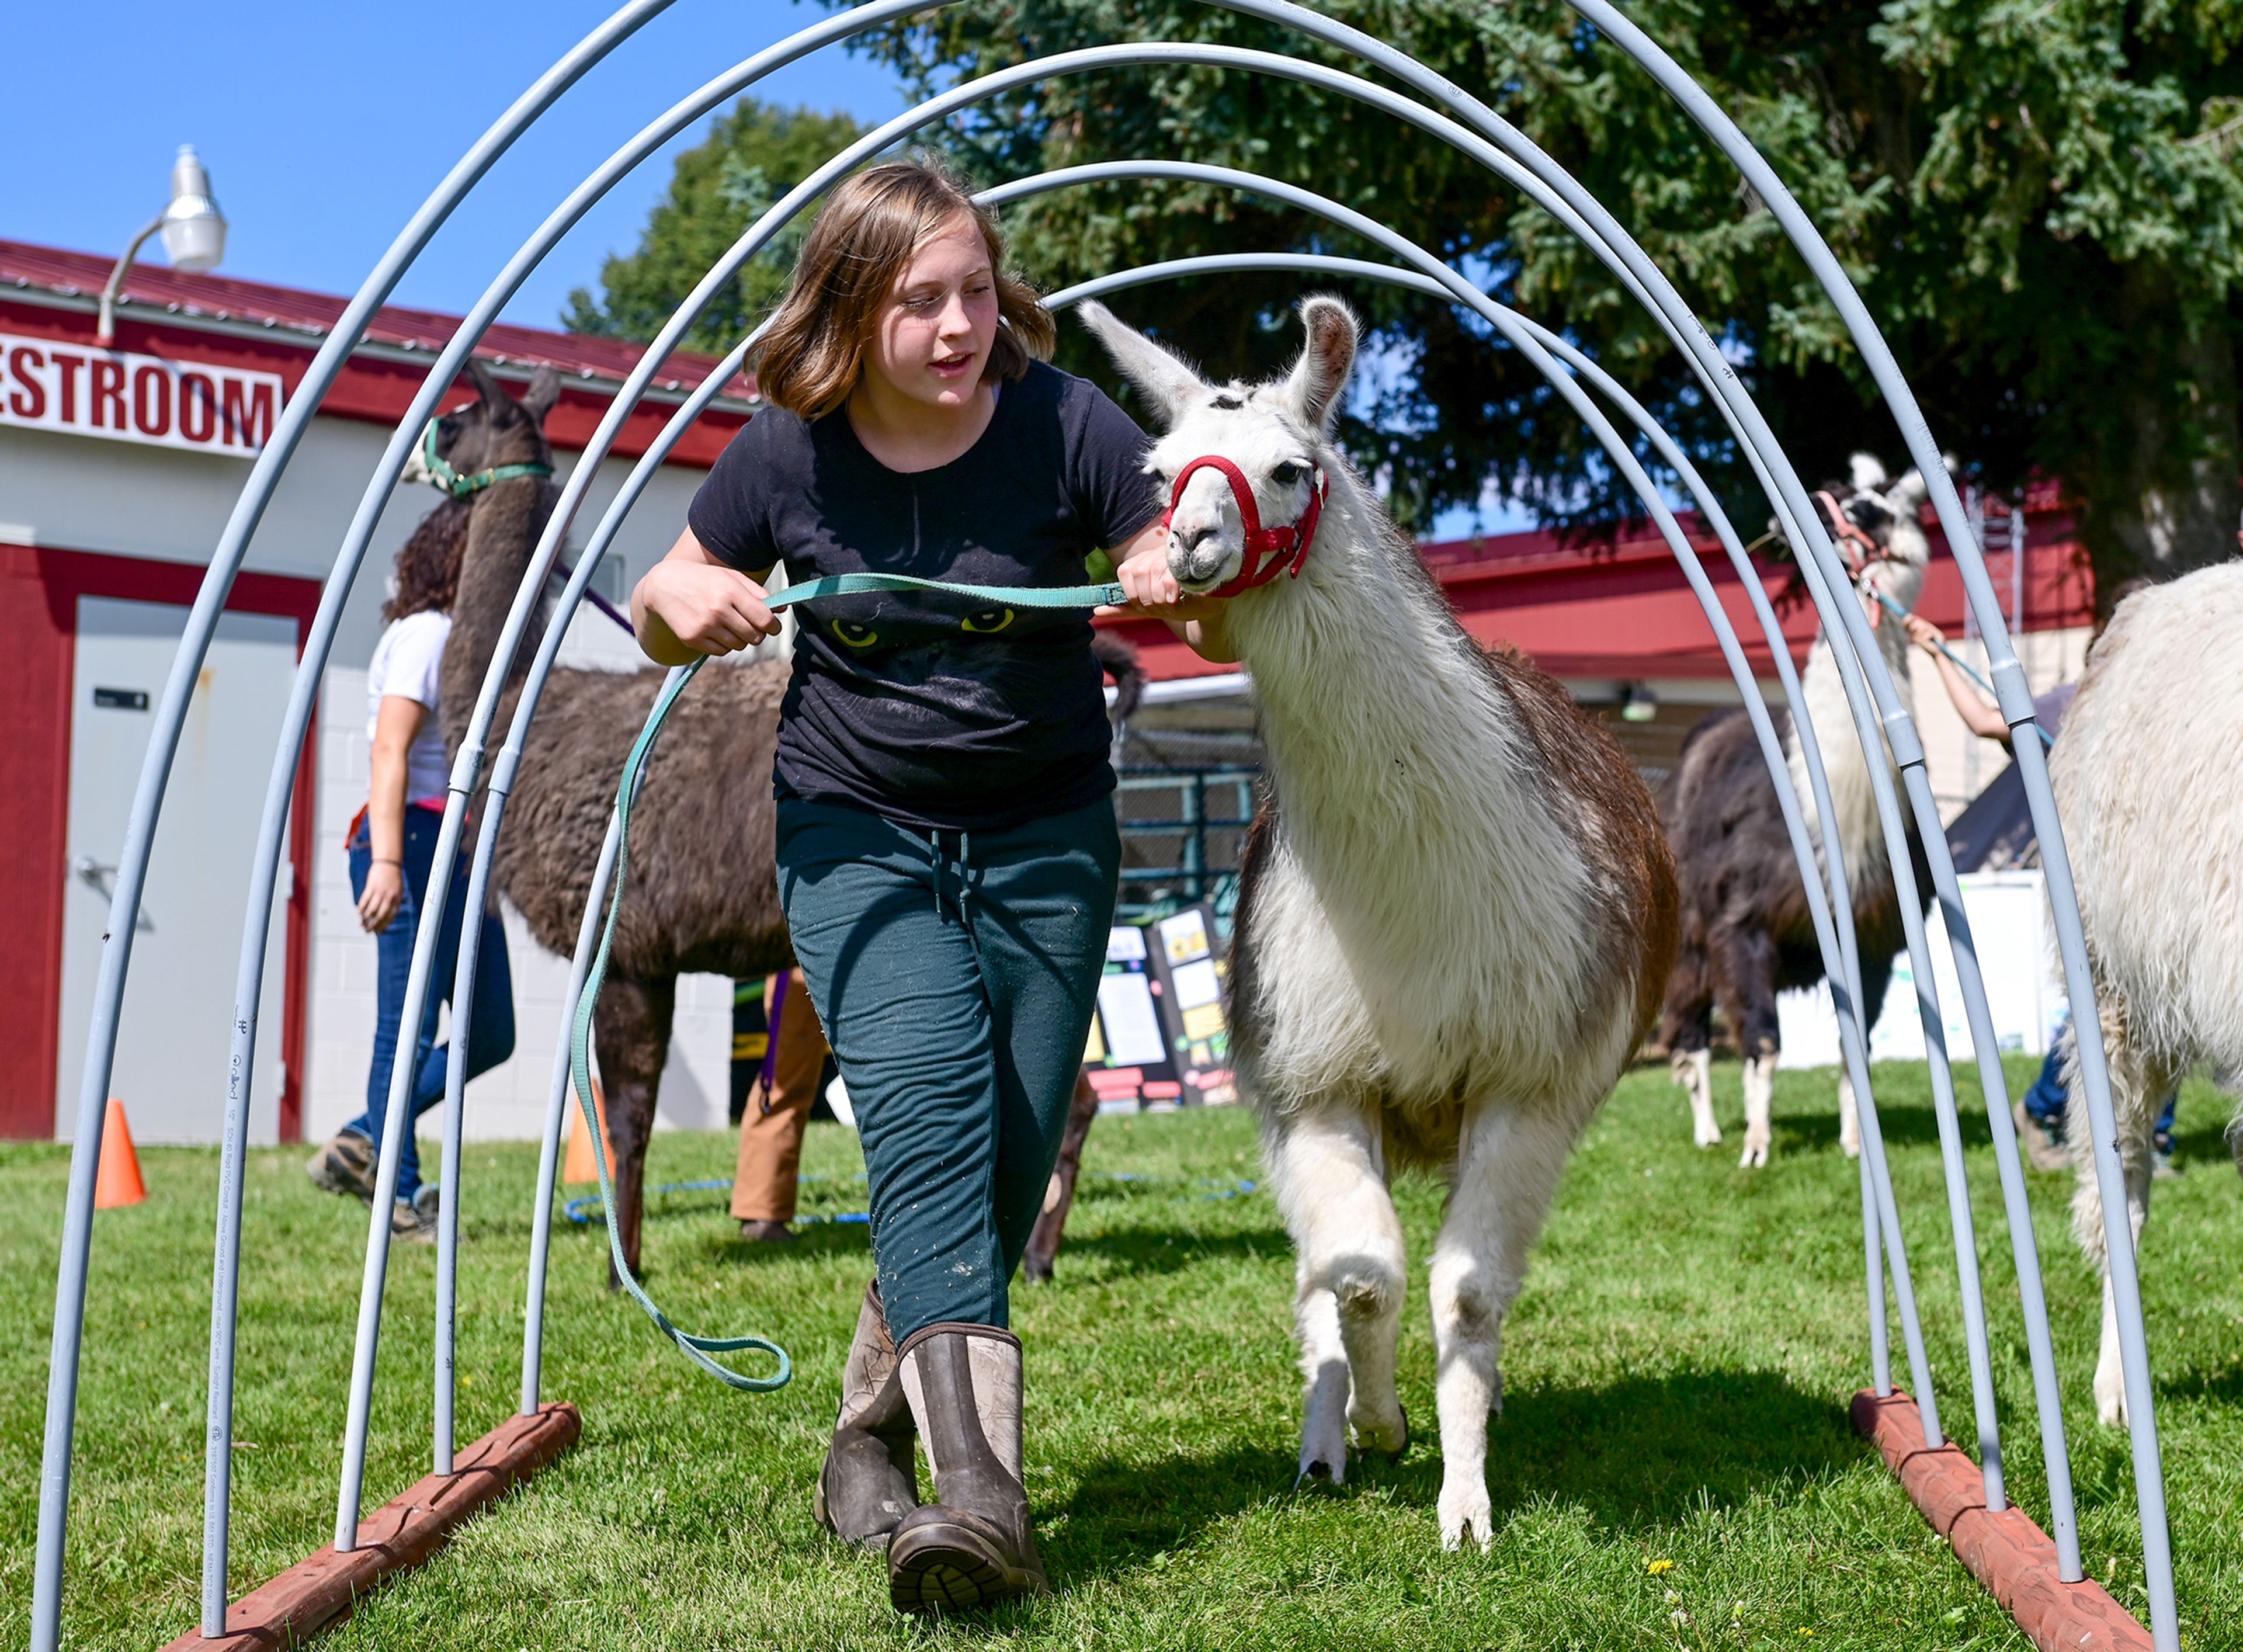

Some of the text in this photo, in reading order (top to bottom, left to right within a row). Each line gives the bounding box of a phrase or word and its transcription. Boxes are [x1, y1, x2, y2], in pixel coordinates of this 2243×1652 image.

[0, 347, 274, 449] STROOM
[225, 1143, 232, 1151] 40
[224, 1153, 232, 1168] Rigid
[221, 1185, 230, 1209] Conduit
[218, 1235, 227, 1257] Ground
[214, 1272, 225, 1310] Underground
[209, 1474, 217, 1502] Conforms
[206, 1588, 212, 1600] SW
